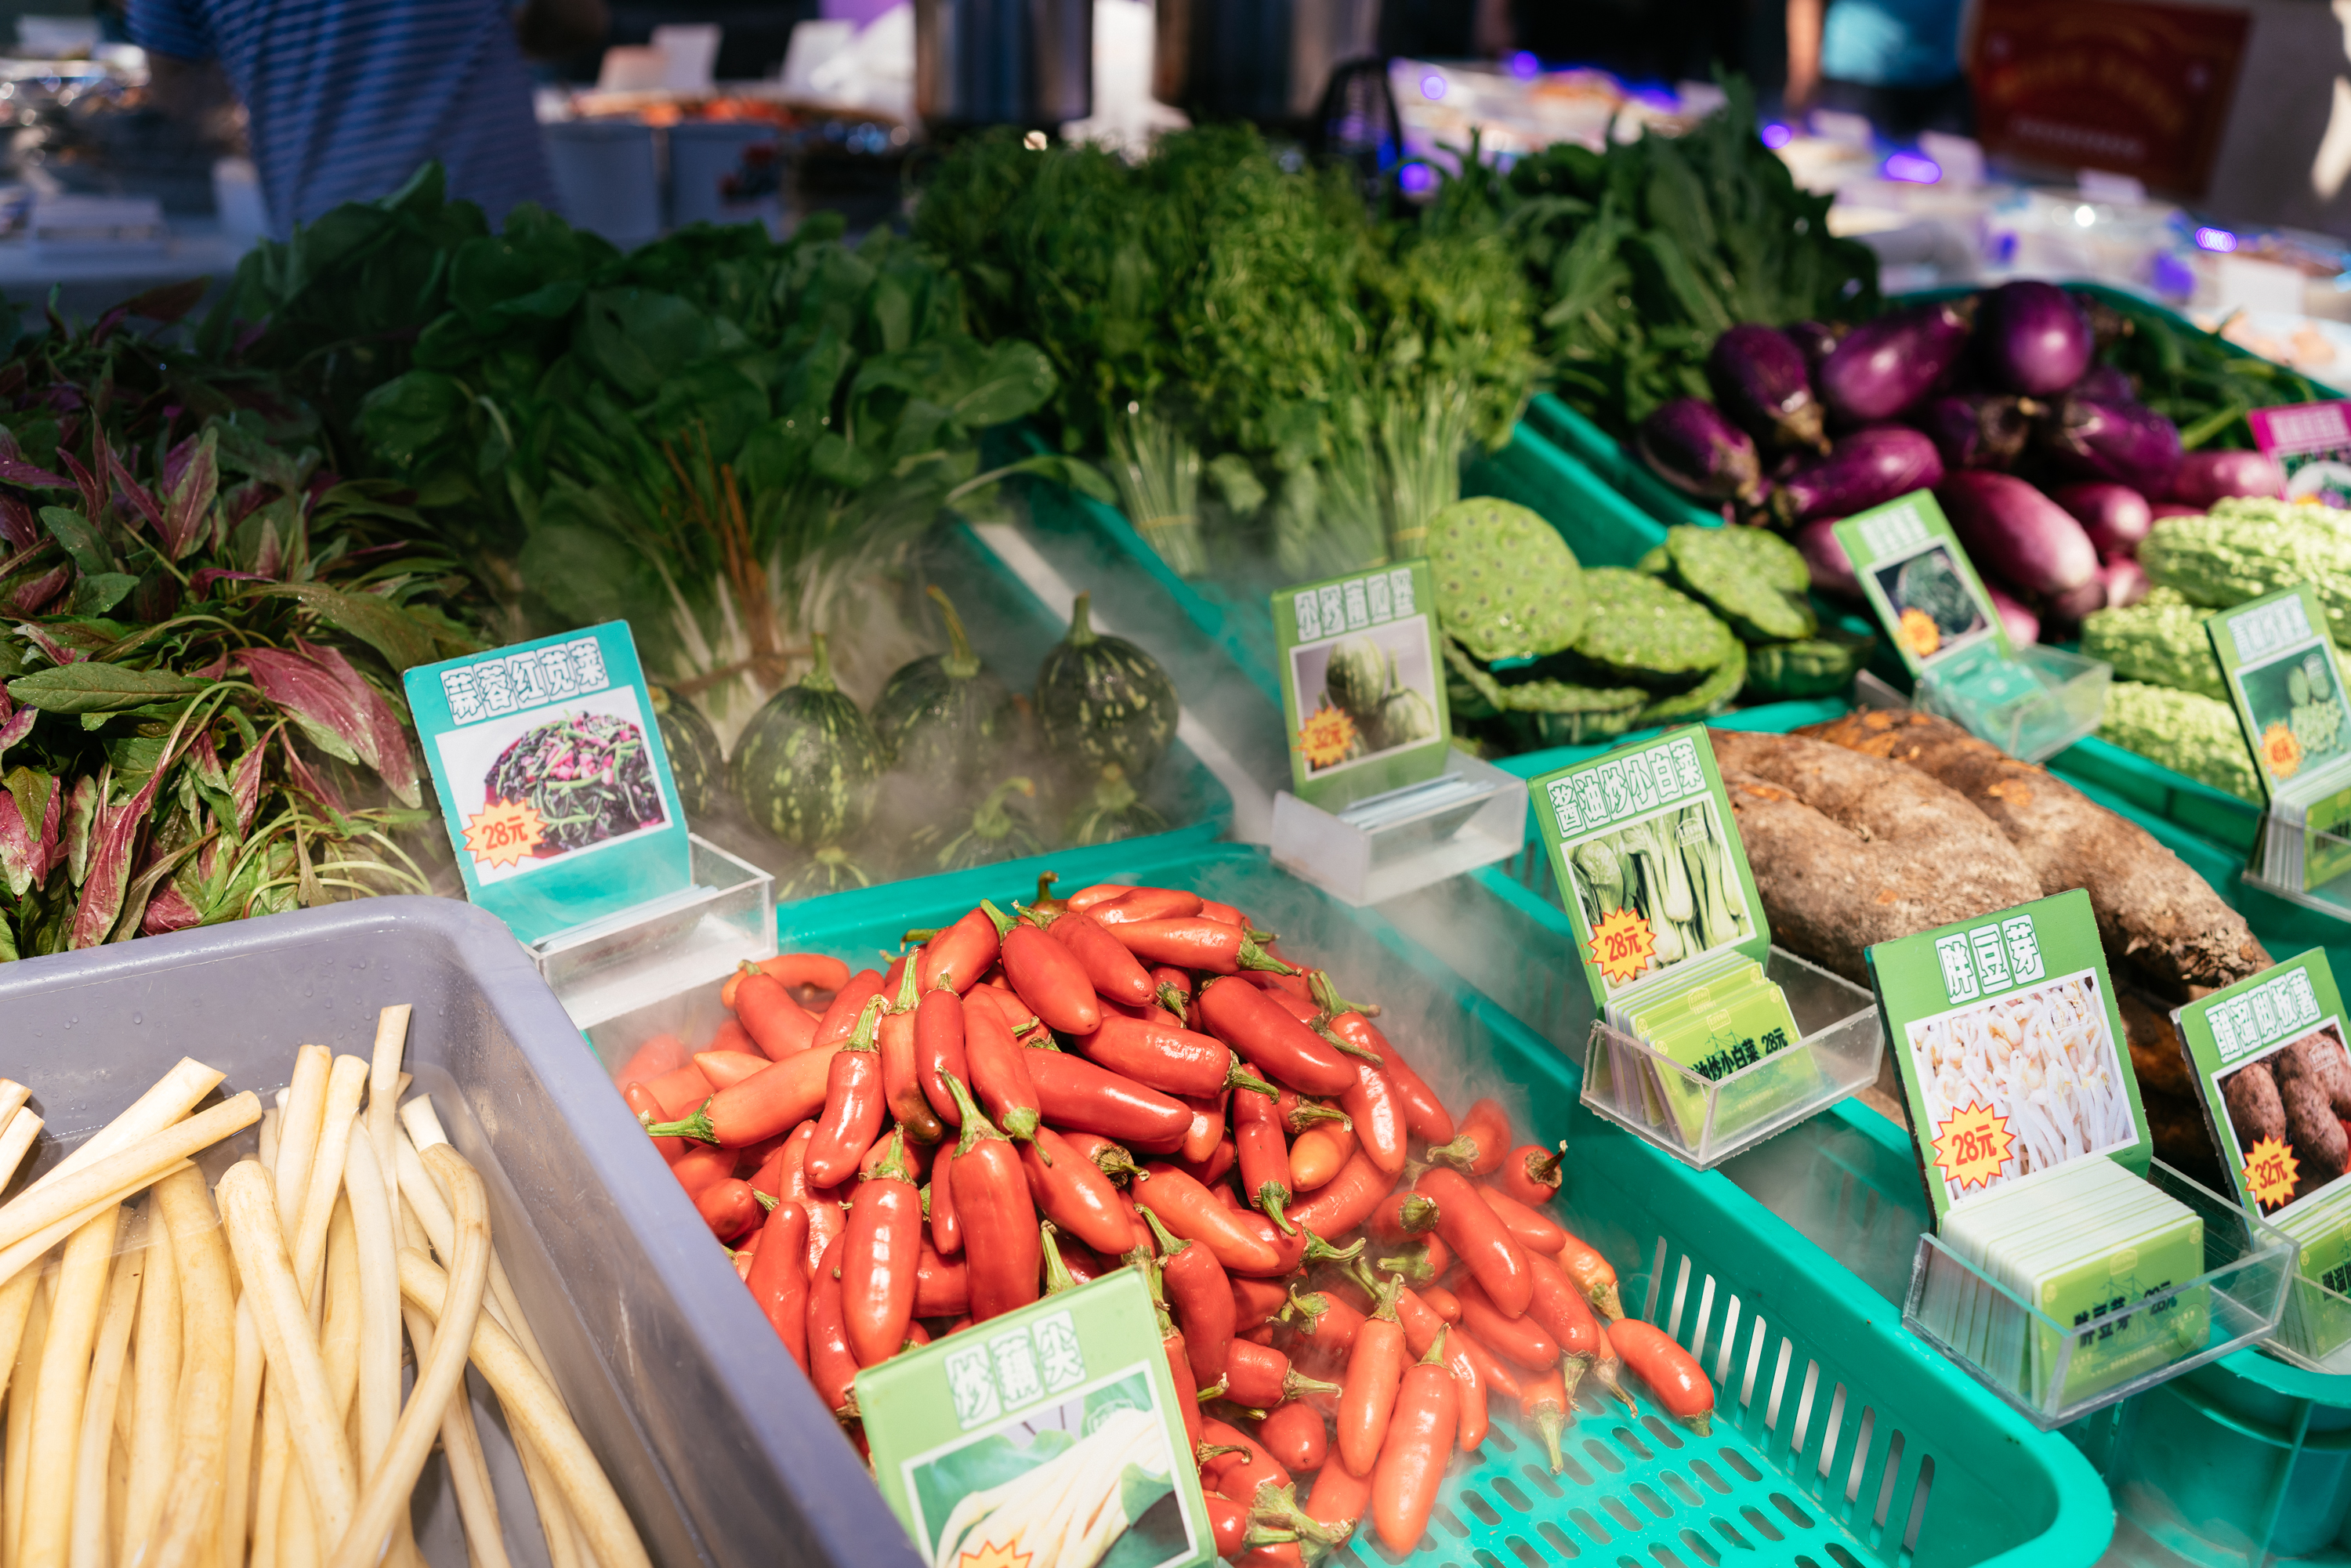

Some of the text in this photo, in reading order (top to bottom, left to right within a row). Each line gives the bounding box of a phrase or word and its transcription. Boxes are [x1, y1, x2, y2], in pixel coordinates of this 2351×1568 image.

[444, 643, 607, 719] 蒜蓉红苋菜
[1549, 743, 1704, 833] 酱油炒小白菜
[481, 816, 528, 849] 28元
[1604, 926, 1643, 961] 28元
[1939, 920, 2041, 1000] 胖豆芽
[1761, 1027, 1788, 1055] 28元
[1951, 1125, 1998, 1167] 28元
[2255, 1155, 2288, 1190] 32元
